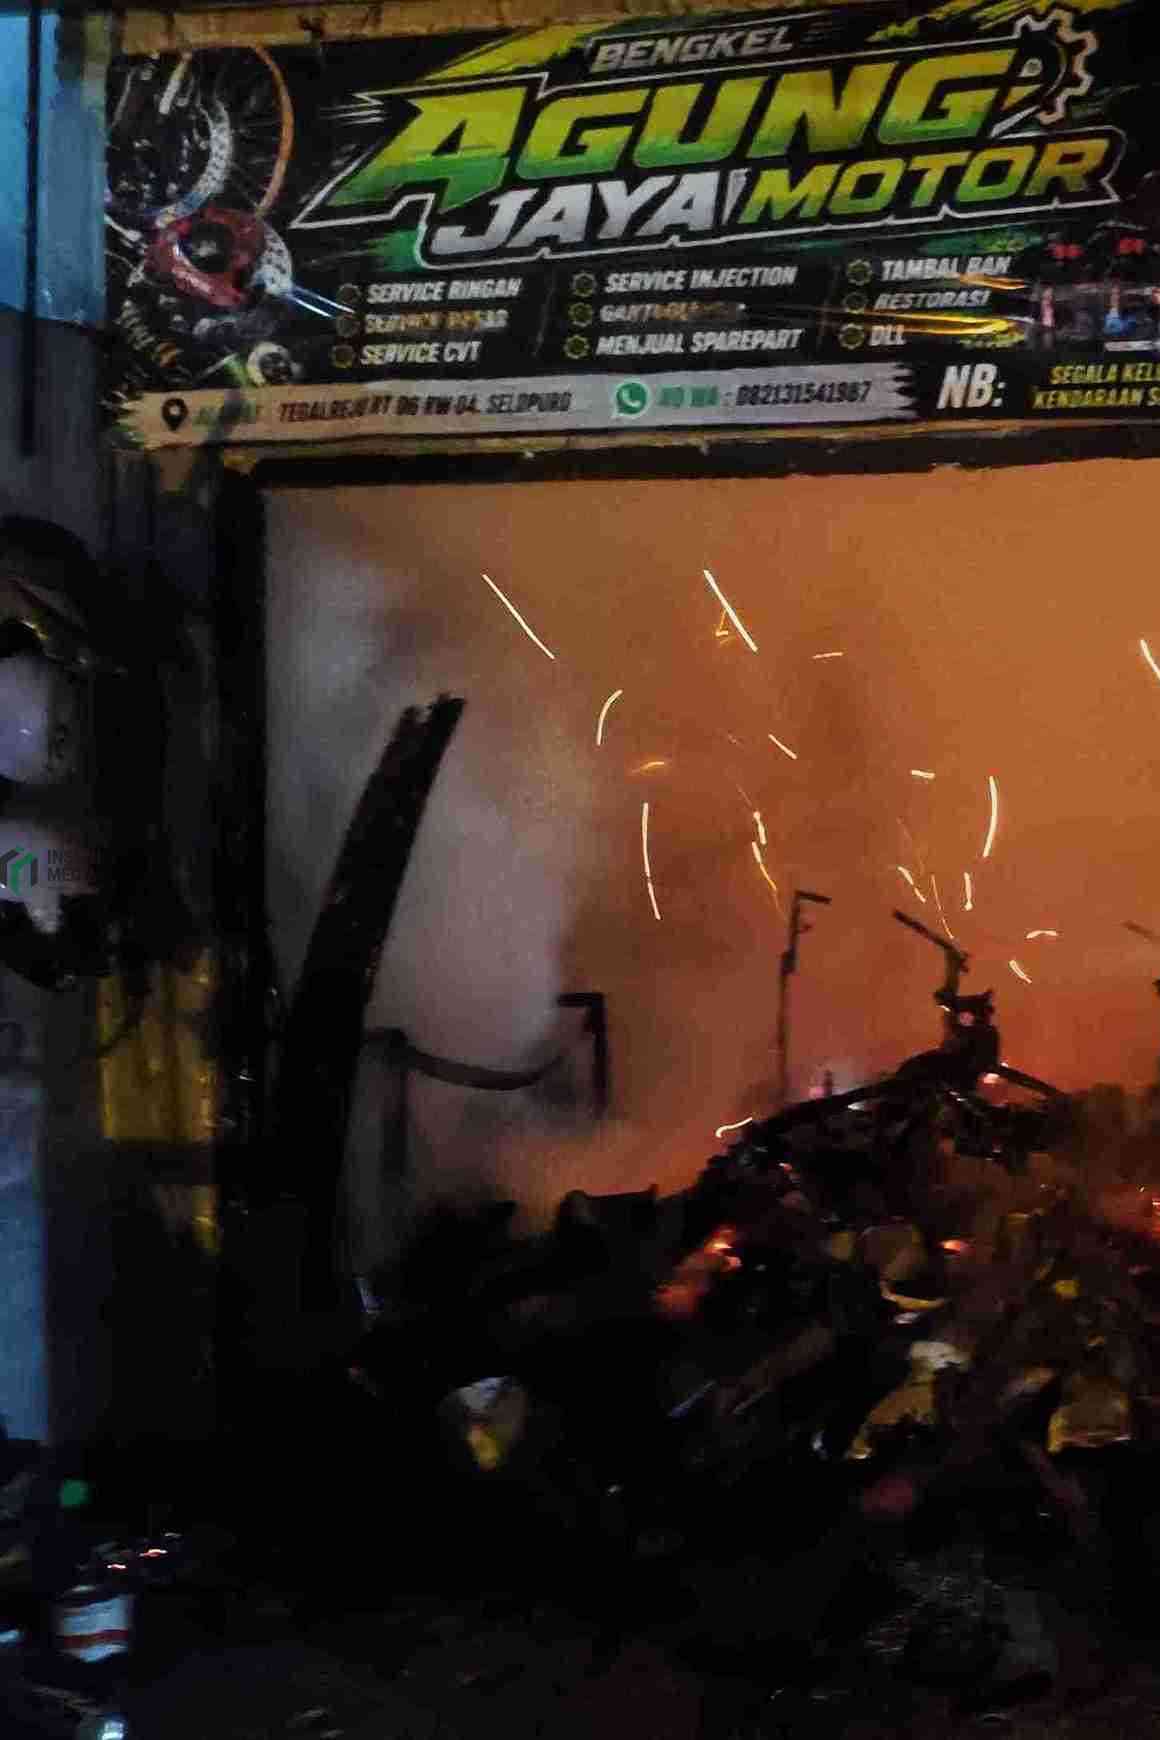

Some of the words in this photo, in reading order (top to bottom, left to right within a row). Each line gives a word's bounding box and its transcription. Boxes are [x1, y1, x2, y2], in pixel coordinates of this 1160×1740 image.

[589, 25, 794, 72] BENGKEL
[324, 48, 1016, 214] AGUNG
[429, 170, 720, 255] JAYA
[737, 139, 1111, 225] MOTOR
[604, 268, 688, 293] SERVICE
[689, 265, 800, 290] INJECTION
[879, 257, 960, 282] TAMBAL
[366, 280, 447, 304] SERVICE
[448, 277, 523, 300] RINGAN
[873, 289, 993, 311] RESTORASI
[360, 342, 441, 366] SERVICE
[443, 340, 482, 363] CVT
[595, 332, 685, 356] MENJUAL
[689, 328, 806, 353] SPAREPART
[936, 362, 1006, 410] NB:
[1049, 362, 1120, 385] SEGALA
